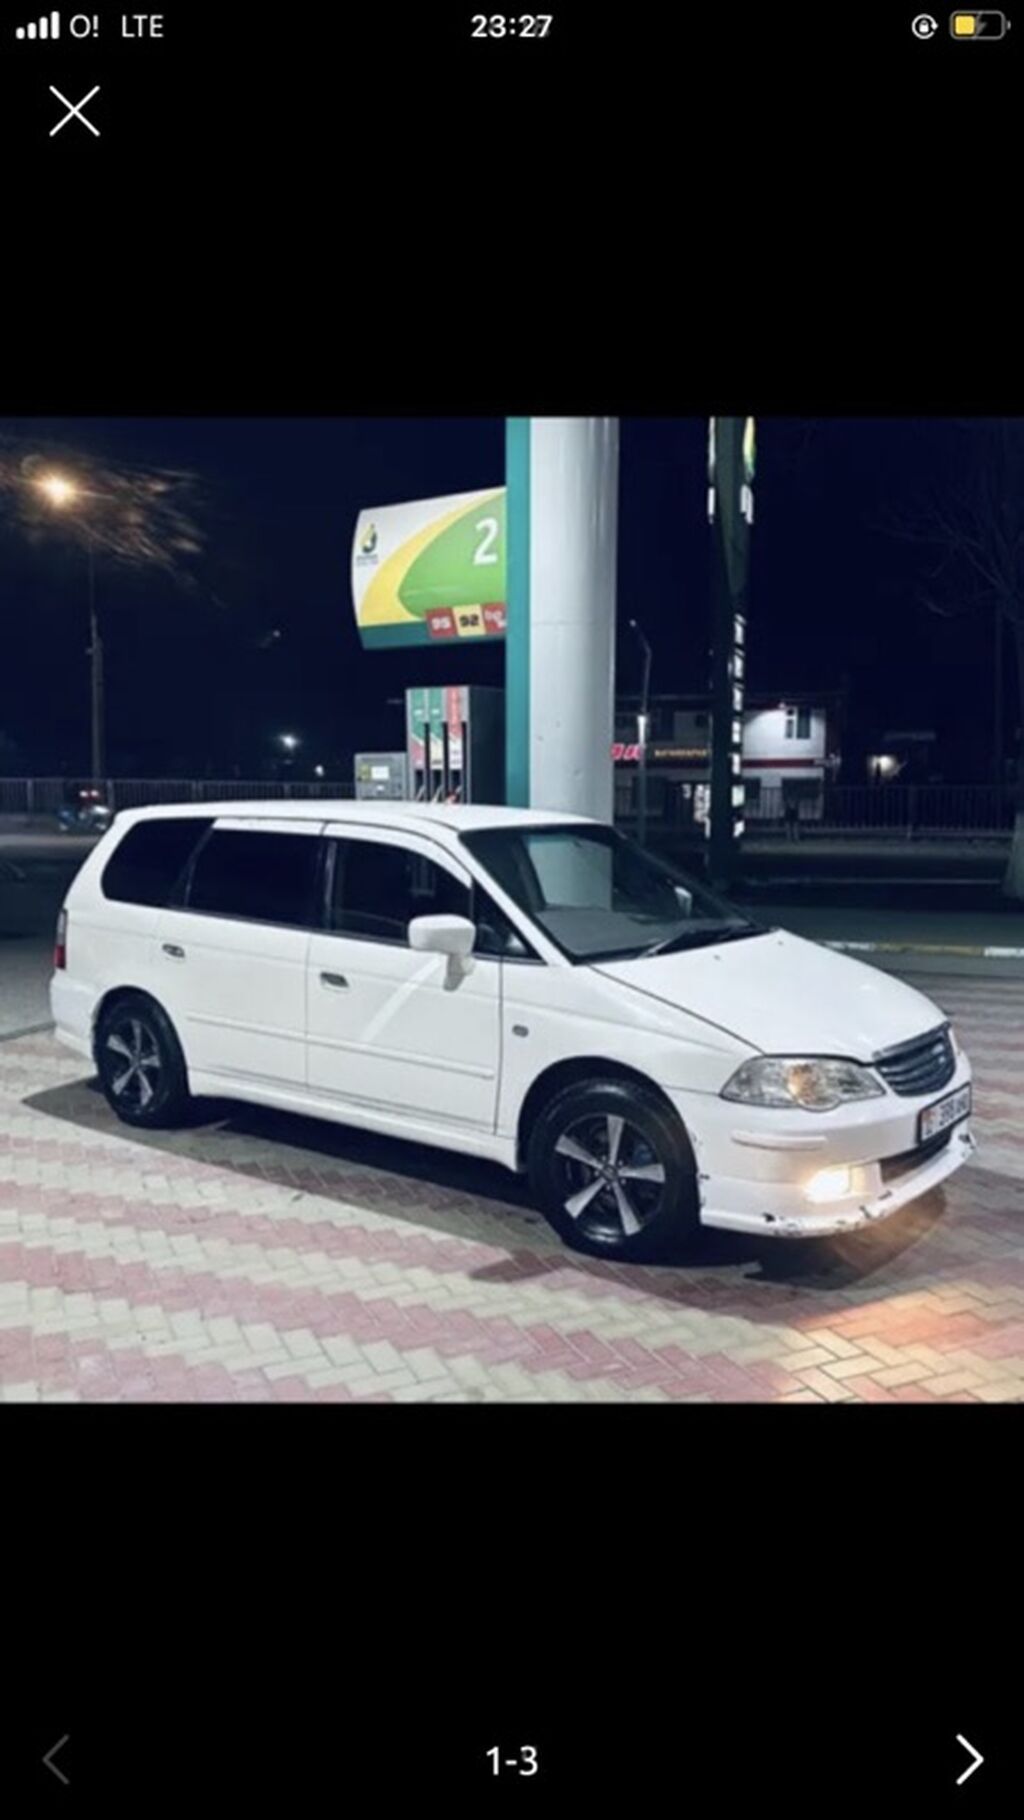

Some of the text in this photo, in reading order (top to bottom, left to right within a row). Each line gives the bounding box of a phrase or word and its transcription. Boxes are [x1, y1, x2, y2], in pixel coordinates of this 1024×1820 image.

[473, 517, 499, 565] 2
[431, 615, 451, 630] 95
[459, 613, 480, 628] 92
